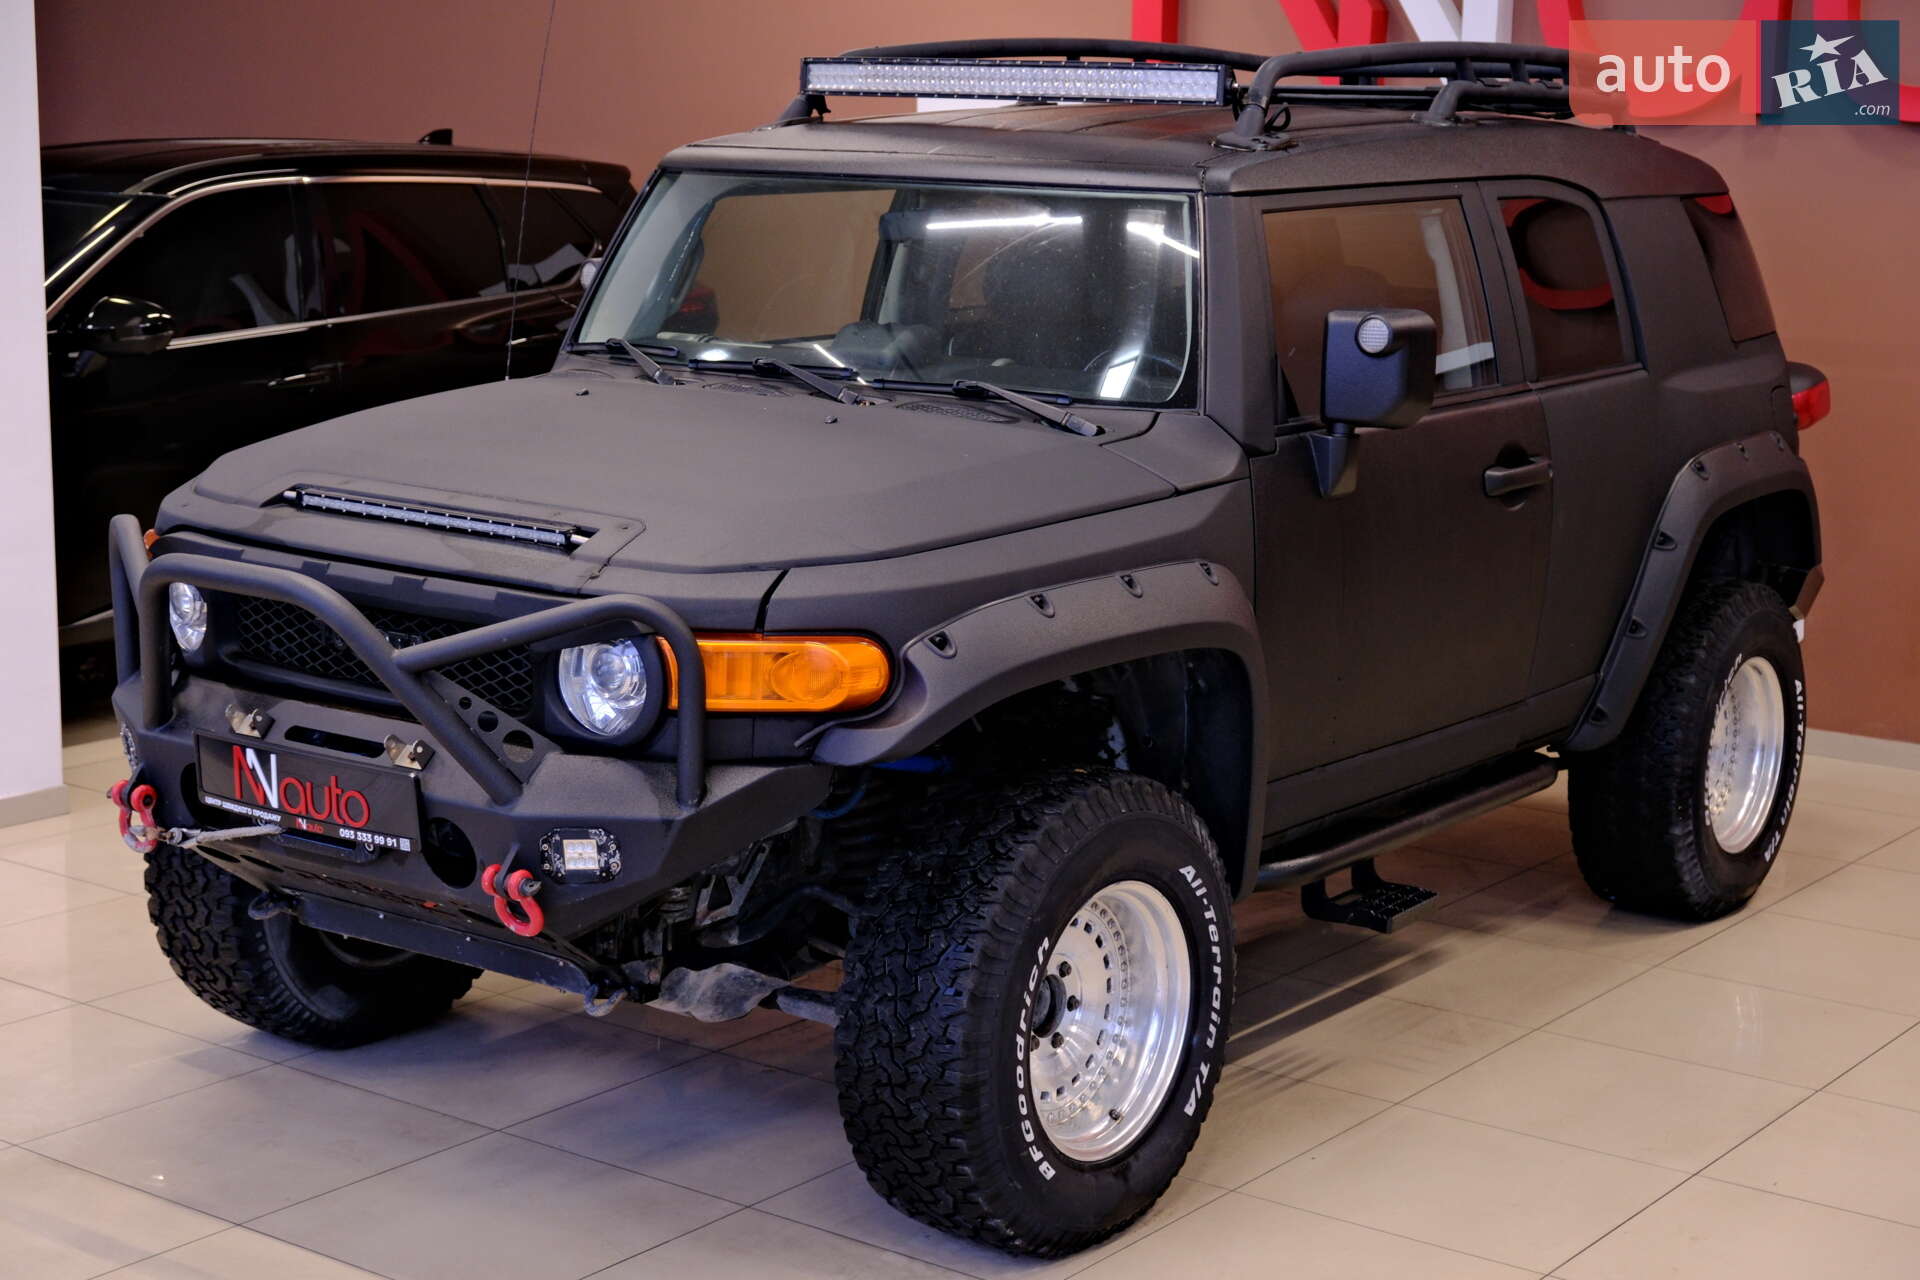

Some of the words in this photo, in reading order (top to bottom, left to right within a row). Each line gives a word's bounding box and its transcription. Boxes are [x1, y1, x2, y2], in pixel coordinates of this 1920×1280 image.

[339, 828, 355, 839] 093
[356, 831, 372, 842] 333
[374, 835, 385, 845] 99
[386, 837, 397, 847] 91
[1179, 865, 1221, 1049] All-Terrain
[1016, 936, 1056, 1181] BFGoodrich
[1184, 1061, 1210, 1117] T/A
